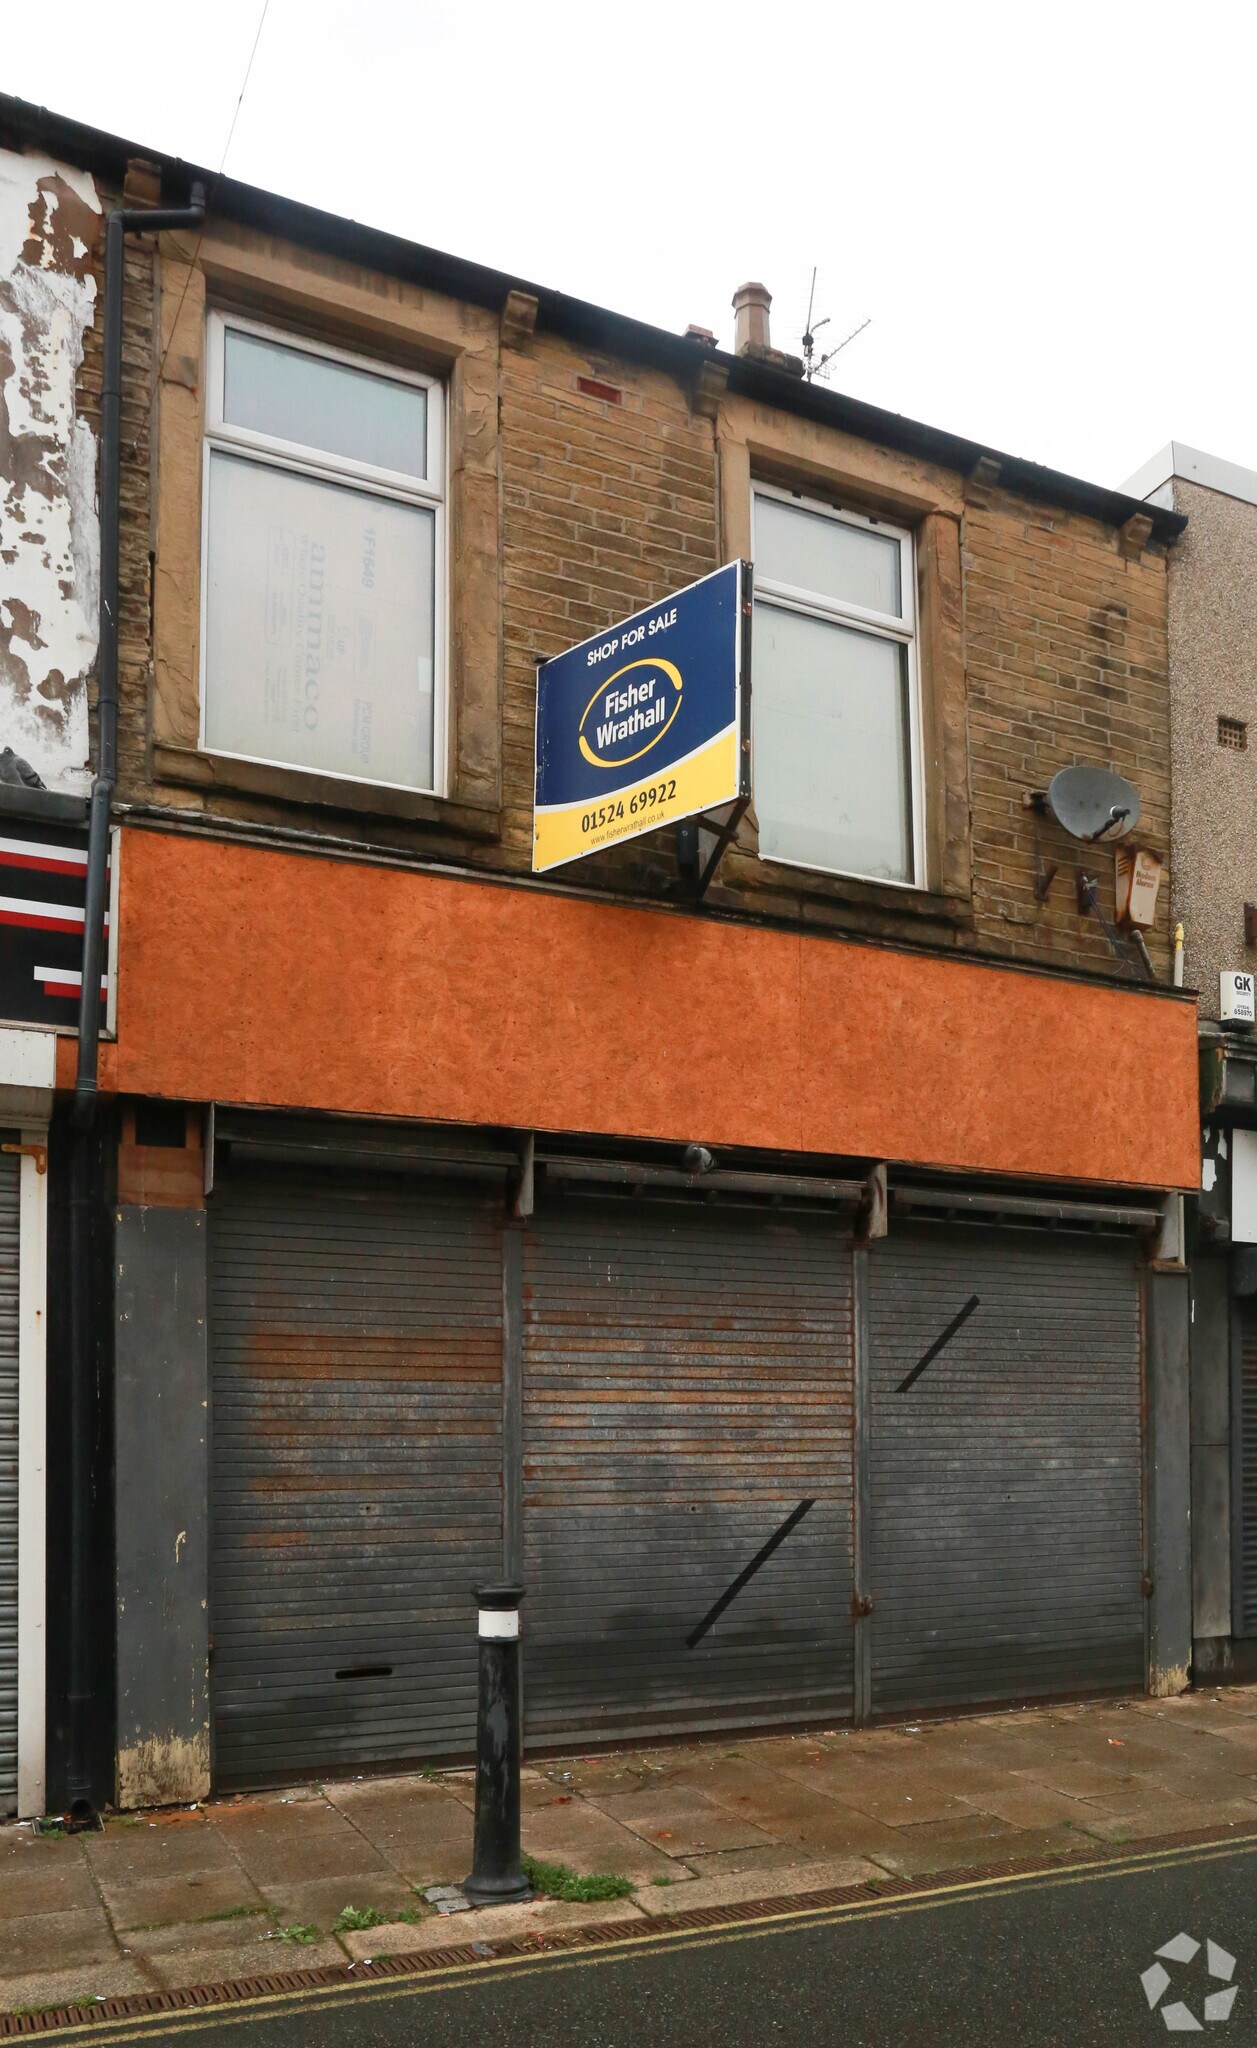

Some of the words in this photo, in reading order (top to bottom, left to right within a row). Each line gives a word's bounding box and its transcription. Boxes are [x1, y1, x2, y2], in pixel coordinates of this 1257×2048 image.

[362, 527, 377, 588] 1F1649
[303, 542, 325, 731] ammaco
[587, 639, 619, 667] SHOP
[621, 625, 645, 650] FOR
[648, 608, 677, 636] SALE
[596, 696, 665, 749] Wrathall
[605, 678, 656, 718] Fisher
[581, 800, 624, 833] 01524
[629, 779, 677, 815] 69922
[590, 811, 665, 845] www.fisherwrathall.co.uk
[1234, 975, 1252, 992] GK
